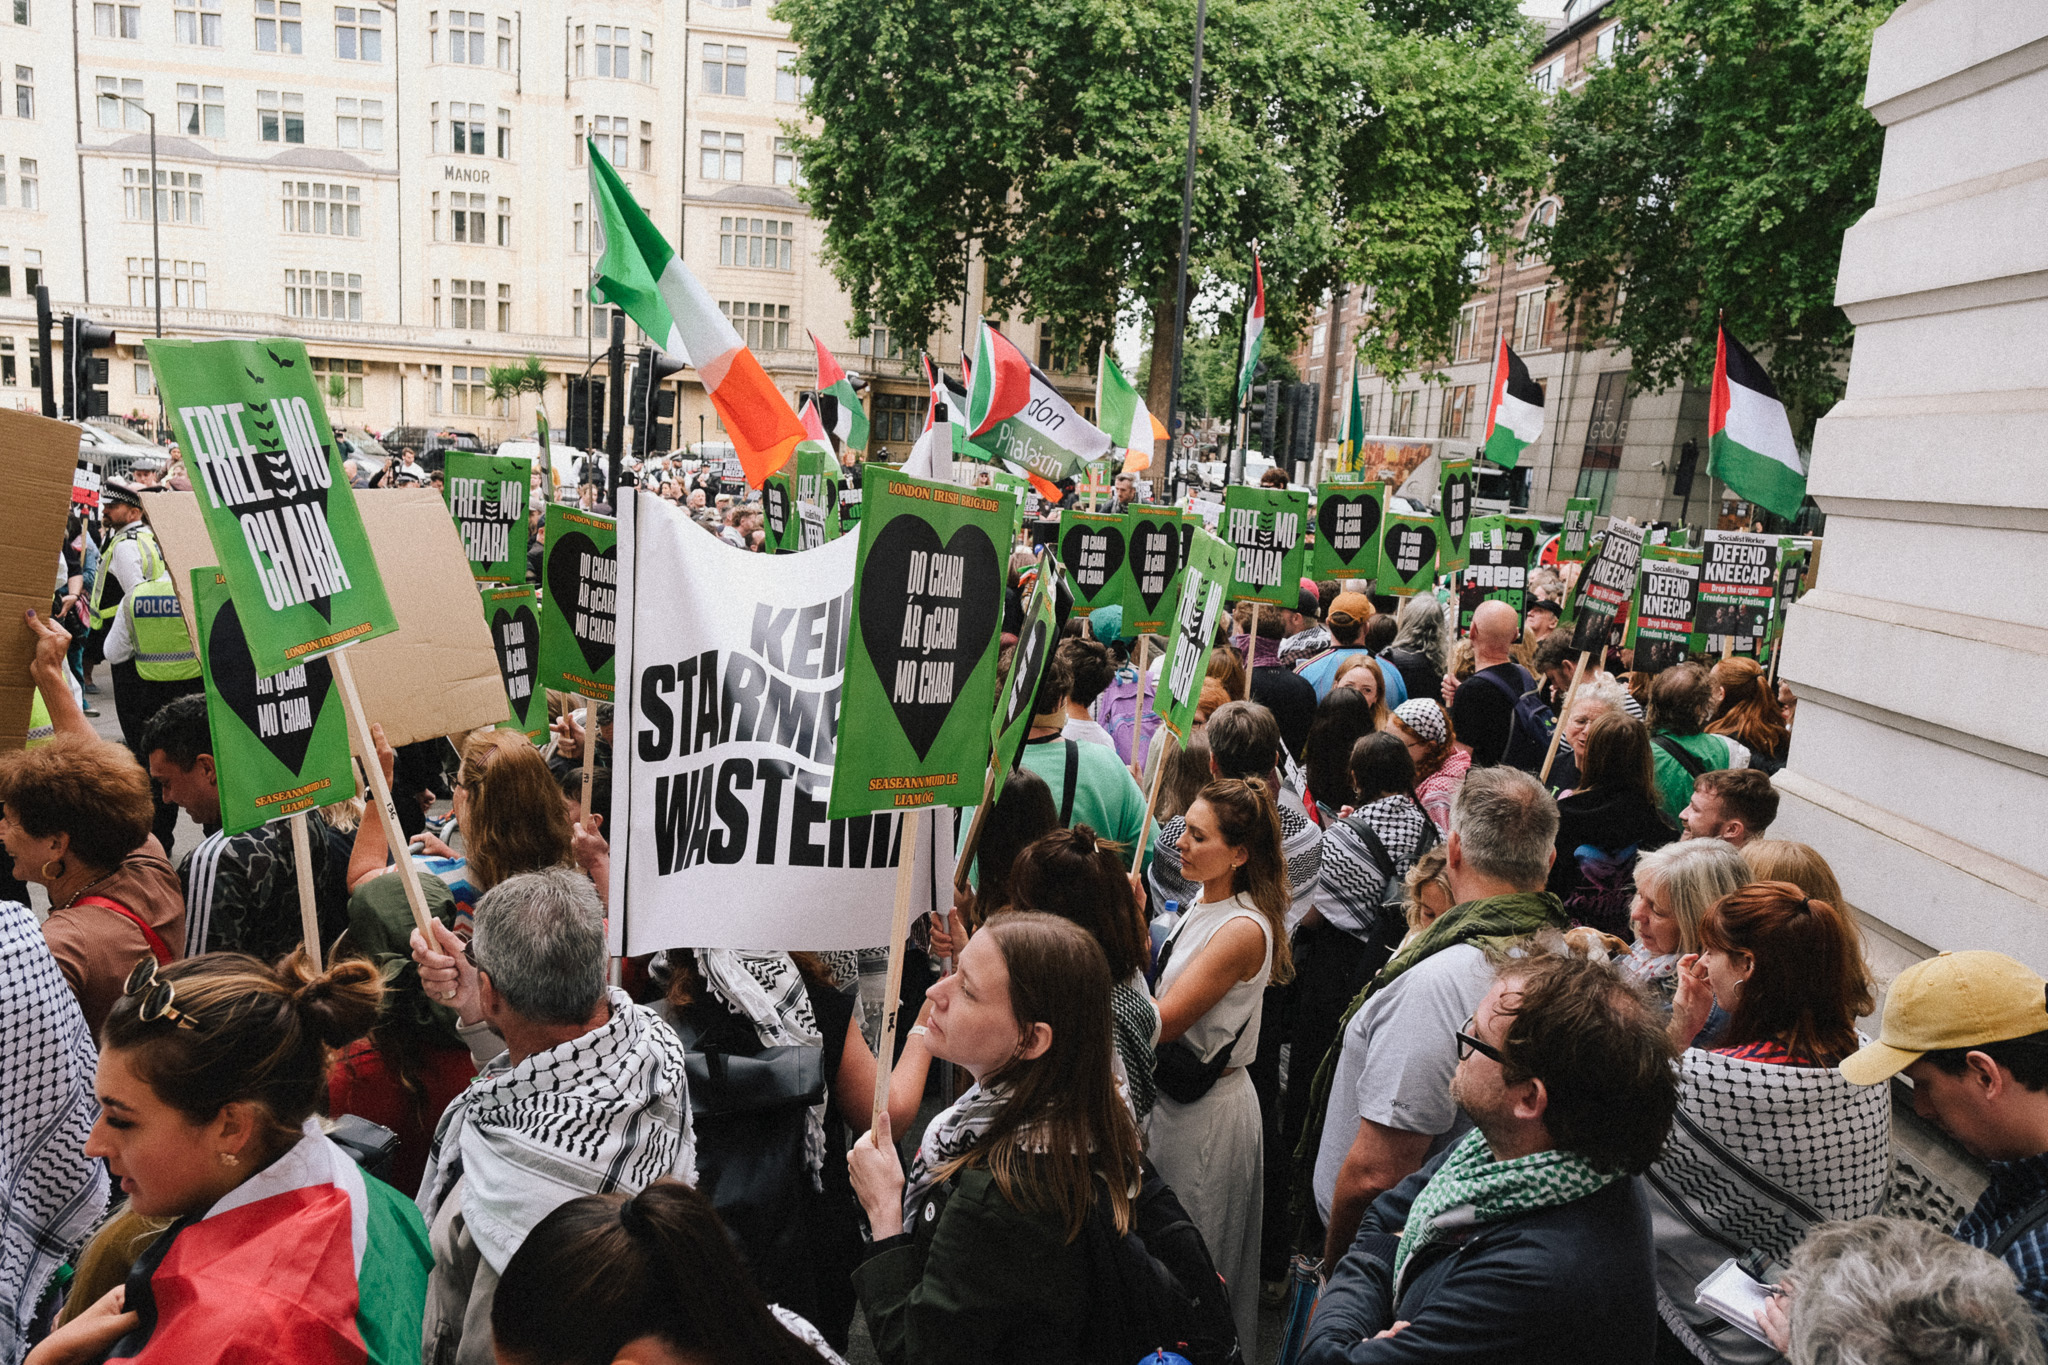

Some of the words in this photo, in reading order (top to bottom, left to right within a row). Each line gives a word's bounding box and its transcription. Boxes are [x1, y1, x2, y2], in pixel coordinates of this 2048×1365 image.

[445, 165, 490, 184] MANOR
[1028, 397, 1065, 431] don
[178, 402, 275, 509] FREE
[270, 396, 332, 491] MO
[450, 477, 485, 519] FREE
[500, 480, 522, 520] MO
[889, 481, 930, 500] LONDON
[933, 489, 960, 505] IRISH
[960, 495, 999, 512] BRIGADE
[562, 512, 591, 526] LONDON
[592, 518, 613, 531] IRISH
[1345, 503, 1362, 517] CHARA
[461, 521, 509, 562] CHARA
[1227, 508, 1261, 546] FREE
[1272, 511, 1298, 549] MO
[1718, 533, 1744, 543] Socialist
[1744, 536, 1766, 545] Worker
[1081, 534, 1090, 550] DO
[1089, 535, 1107, 551] CHARA
[1343, 535, 1360, 549] CHARA
[1603, 534, 1640, 568] DEFEND
[1712, 543, 1767, 566] DEFEND
[240, 501, 352, 612] CHARA
[580, 552, 590, 579] DO
[592, 555, 617, 585] CHAR
[1235, 546, 1283, 587] CHARA
[1652, 564, 1676, 574] Socialist
[907, 550, 928, 596] DO
[928, 552, 964, 599] CHARA
[1077, 569, 1087, 584] MO
[1086, 570, 1104, 585] CHARA
[1648, 573, 1690, 599] DEFEND
[1704, 562, 1771, 585] KNEECAP
[578, 577, 589, 608] ÁR
[590, 587, 616, 615] gCAR
[1703, 593, 1729, 602] Freedom
[1729, 595, 1738, 603] for
[1739, 597, 1766, 606] Palestine
[1711, 584, 1726, 594] Drop
[1726, 585, 1737, 593] the
[1737, 587, 1759, 596] charges
[135, 600, 180, 614] POLICE
[1642, 594, 1691, 620] KNEECAP
[575, 611, 587, 638] MO
[901, 596, 922, 650] ÁR
[922, 606, 959, 655] gCARA
[1640, 627, 1663, 640] Freedom
[1669, 631, 1687, 643] Palestine
[1647, 618, 1661, 629] Drop
[1661, 619, 1669, 628] the
[1668, 621, 1683, 630] charges
[284, 639, 320, 660] LONDON
[319, 631, 344, 648] IRISH
[341, 621, 373, 641] BRIGADE
[893, 660, 917, 703] MO
[918, 661, 954, 704] CHARA
[257, 702, 279, 738] MO
[279, 696, 313, 734] CHARA
[637, 650, 842, 766] STARME
[946, 773, 959, 786] LE
[280, 799, 305, 815] LIAM
[894, 793, 921, 807] LIAM
[921, 790, 934, 804] ÓG
[654, 757, 904, 877] WASTEM
